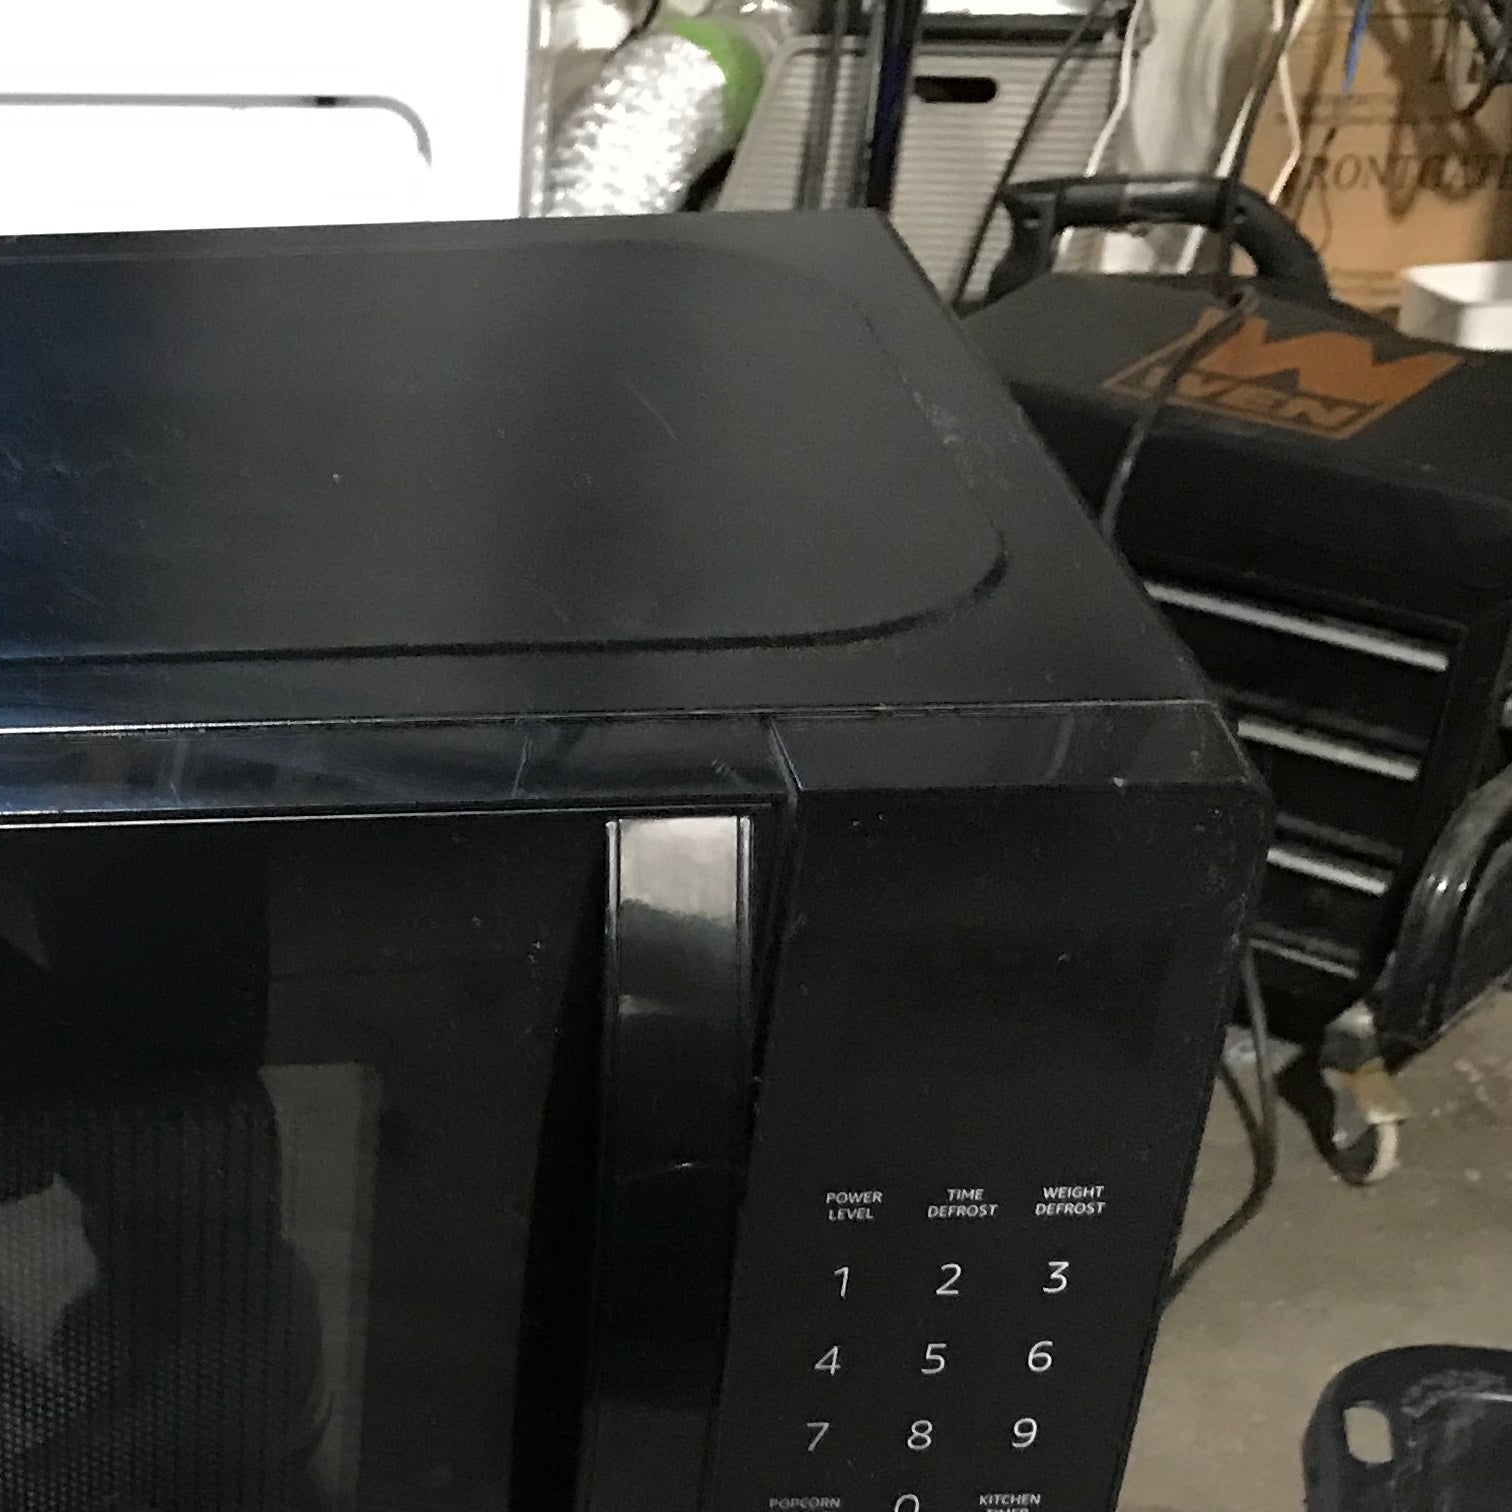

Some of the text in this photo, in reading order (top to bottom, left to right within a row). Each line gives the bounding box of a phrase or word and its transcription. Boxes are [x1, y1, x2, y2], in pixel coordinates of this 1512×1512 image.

[825, 1189, 883, 1205] POWER
[946, 1187, 984, 1202] TIME
[1042, 1184, 1105, 1200] WEIGHT
[828, 1206, 874, 1221] LEVEL
[927, 1203, 999, 1218] DEFROST
[1034, 1200, 1106, 1217] DEFROST
[833, 1266, 849, 1297] 1
[935, 1262, 962, 1296] 2
[1042, 1260, 1070, 1294] 3
[814, 1344, 841, 1375] 4
[920, 1342, 947, 1375] 5
[1026, 1340, 1054, 1373] 6
[806, 1421, 830, 1453] 7
[906, 1419, 933, 1451] 8
[1011, 1417, 1038, 1449] 9
[768, 1496, 841, 1510] POPCORN
[978, 1492, 1042, 1507] KITCHEN
